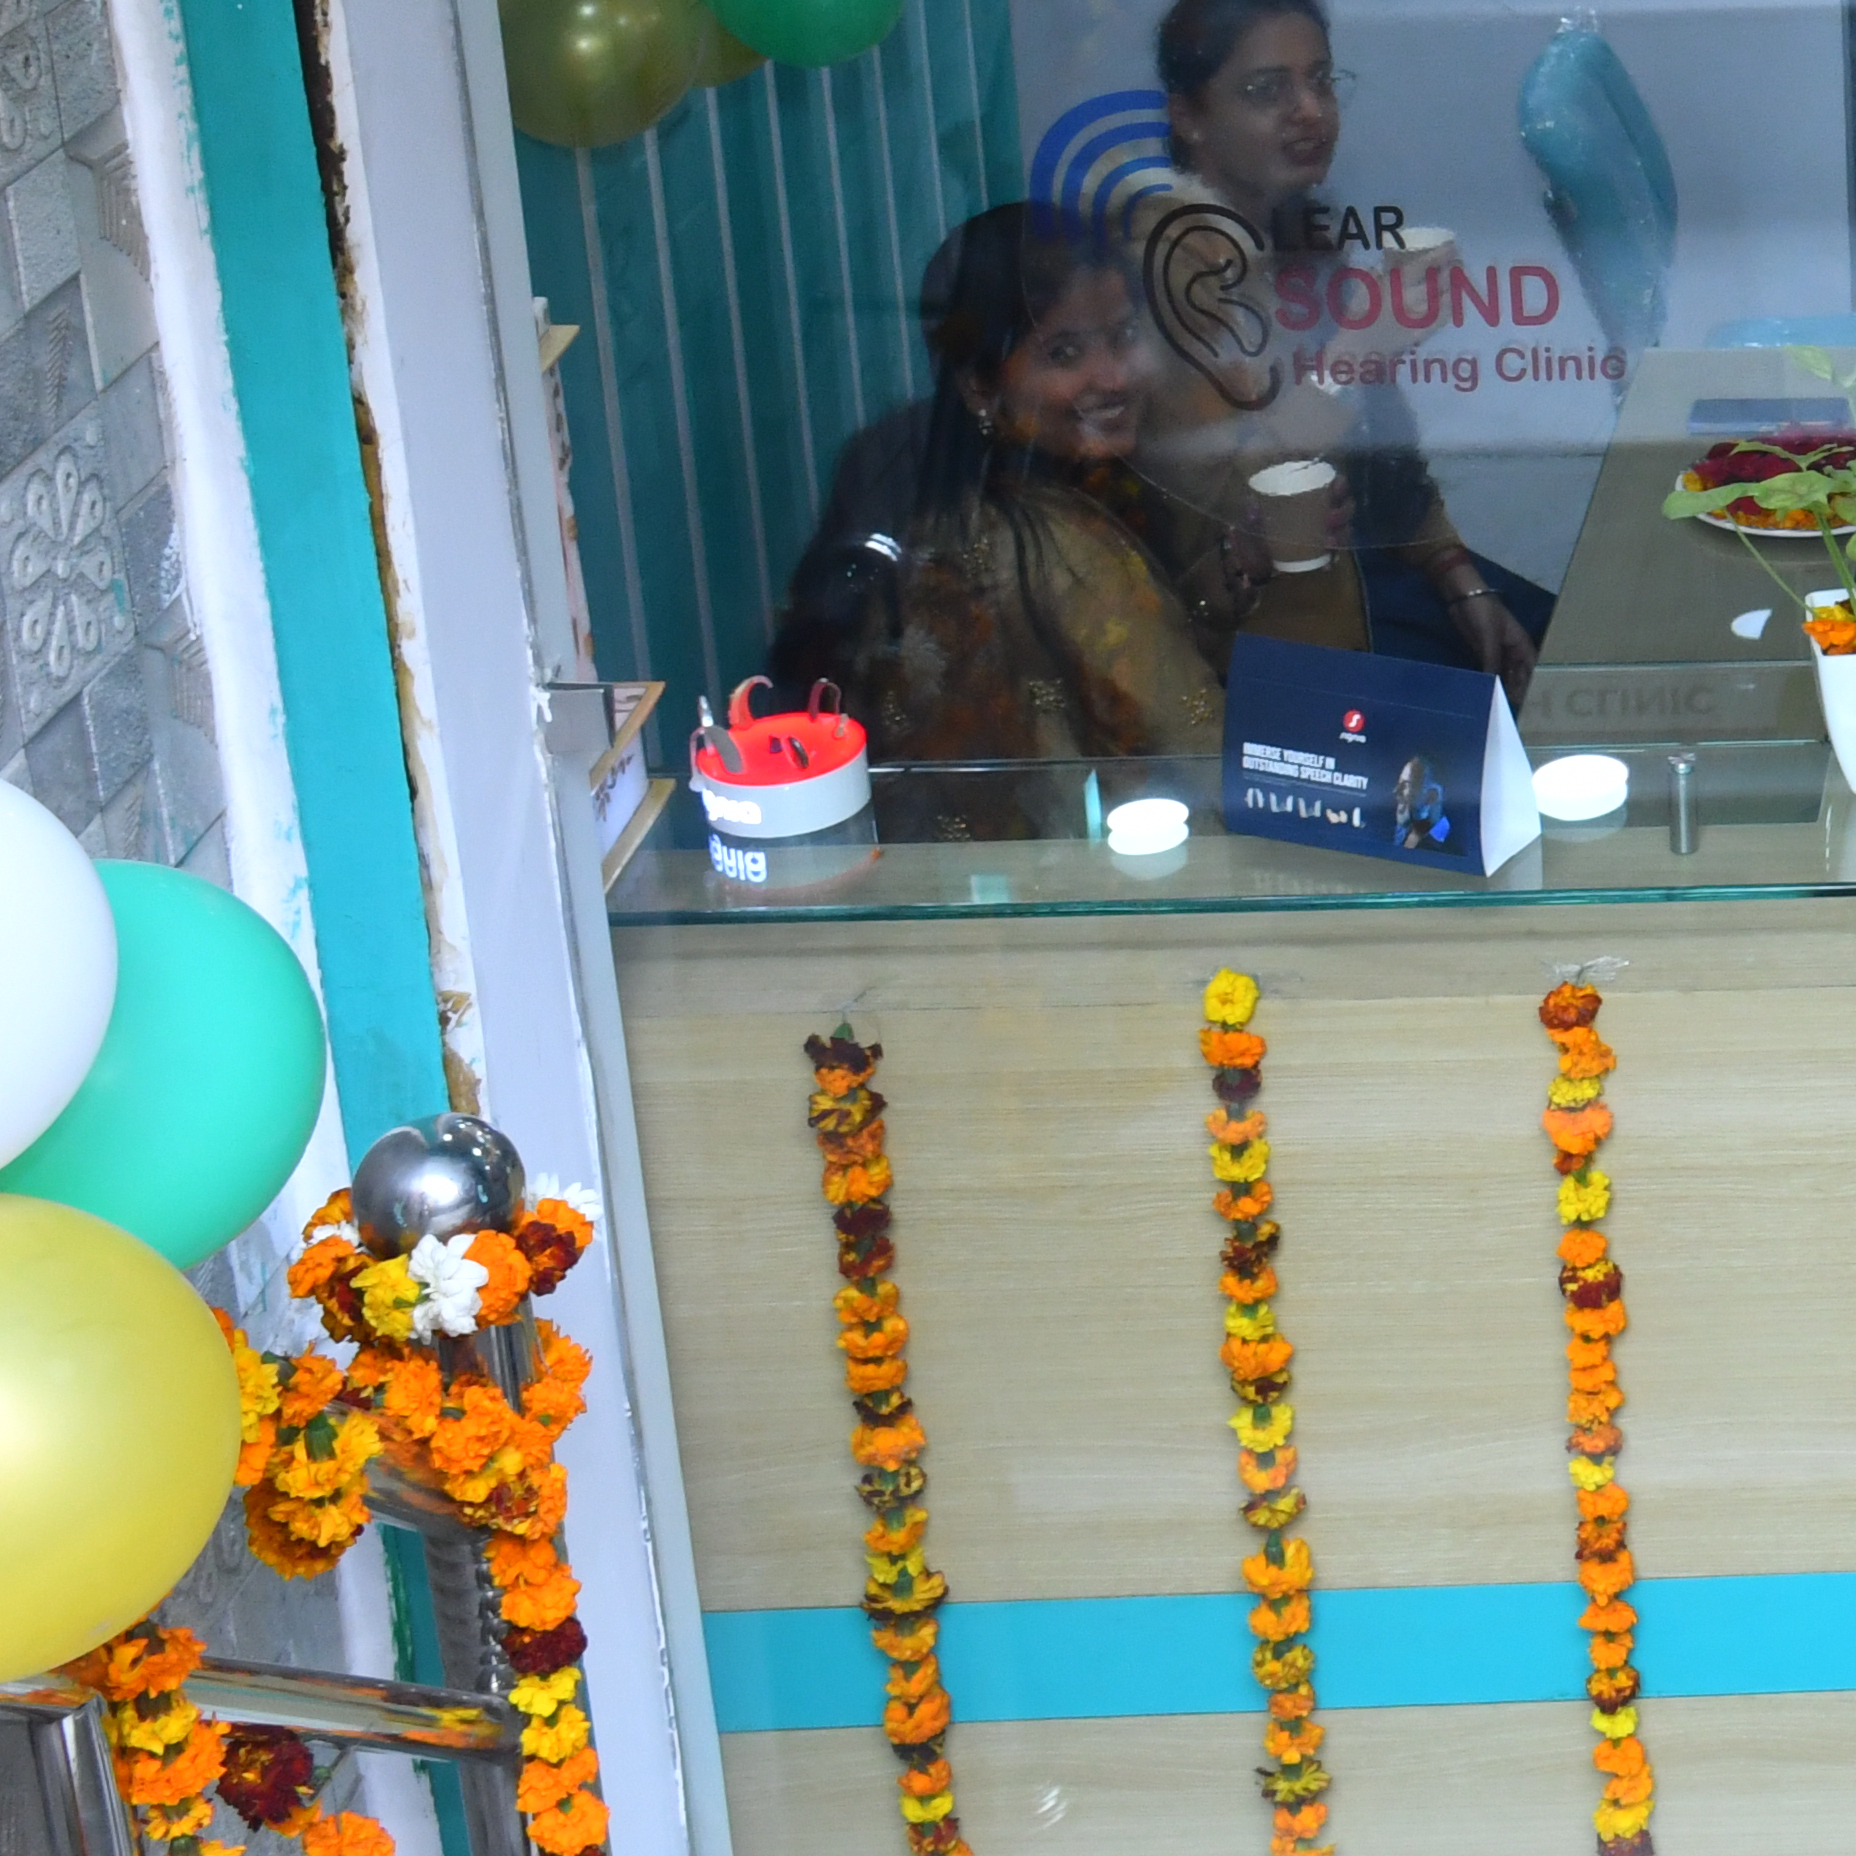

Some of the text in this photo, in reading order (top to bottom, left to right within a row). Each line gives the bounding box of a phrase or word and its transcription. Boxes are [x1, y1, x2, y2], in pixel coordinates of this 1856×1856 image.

[1274, 265, 1560, 331] SOUND
[1292, 346, 1628, 393] Hearing Clinic
